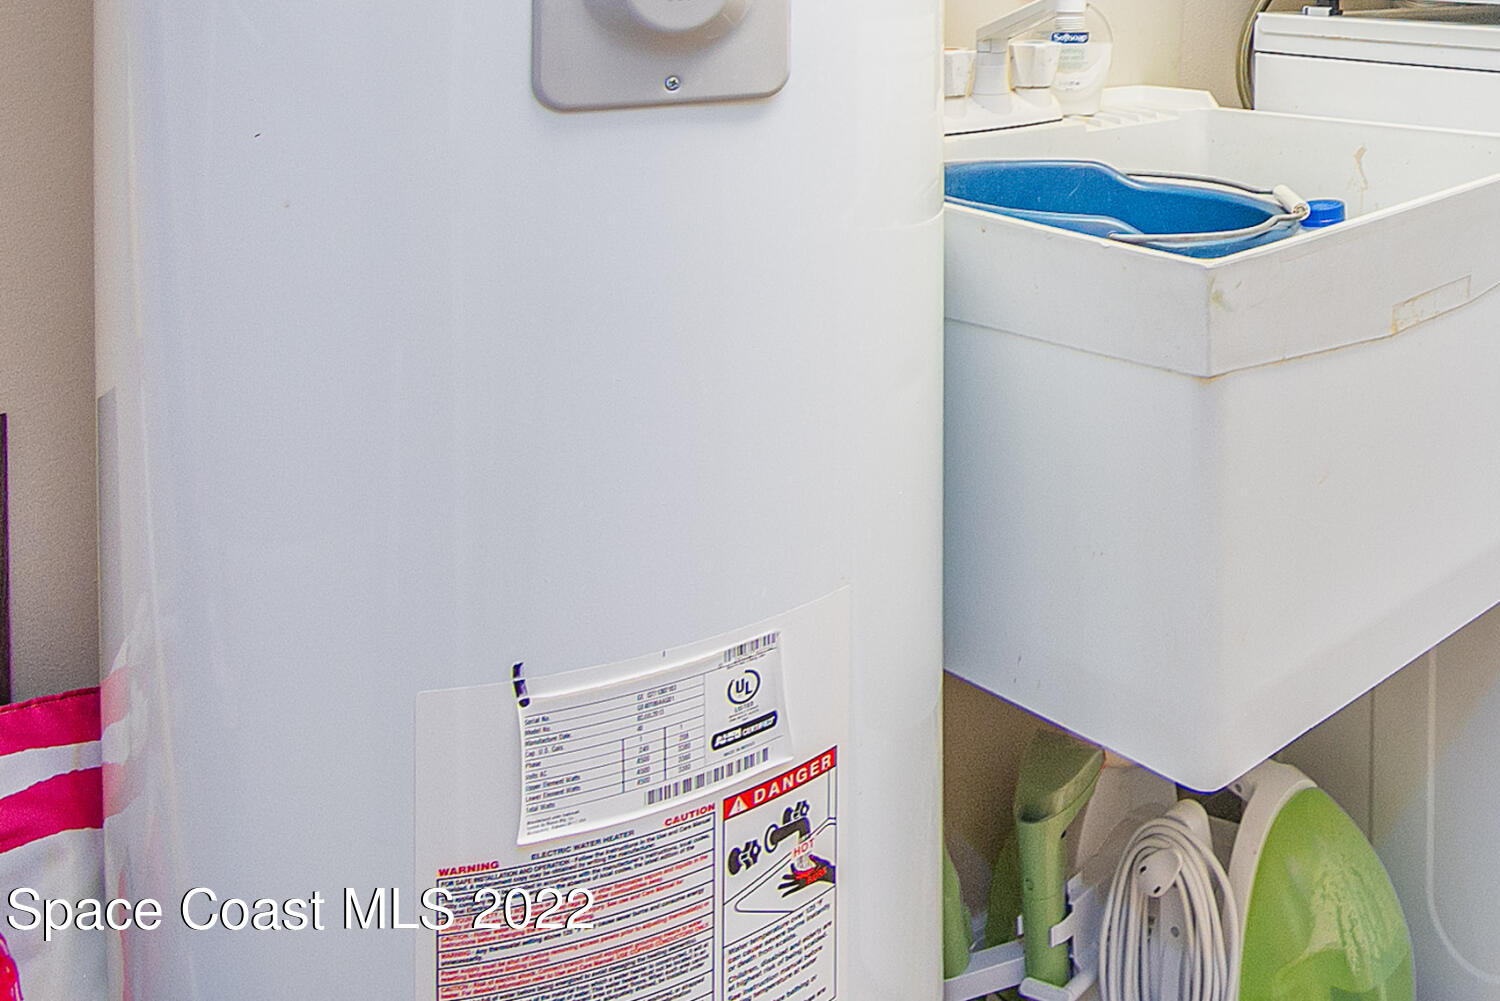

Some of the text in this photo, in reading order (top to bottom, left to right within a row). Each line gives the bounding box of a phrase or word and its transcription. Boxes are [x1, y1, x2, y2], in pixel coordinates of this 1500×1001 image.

[736, 678, 753, 695] UL
[753, 754, 832, 804] DANGER
[664, 803, 715, 826] CAUTION
[531, 830, 634, 860] ELECTRIC WATER HEATER
[793, 839, 814, 856] HOT
[439, 861, 499, 877] WARNING
[751, 921, 789, 944] temperature
[728, 955, 741, 964] can
[742, 944, 763, 957] cause
[765, 931, 785, 945] severe
[738, 955, 756, 968] death
[758, 946, 774, 957] from
